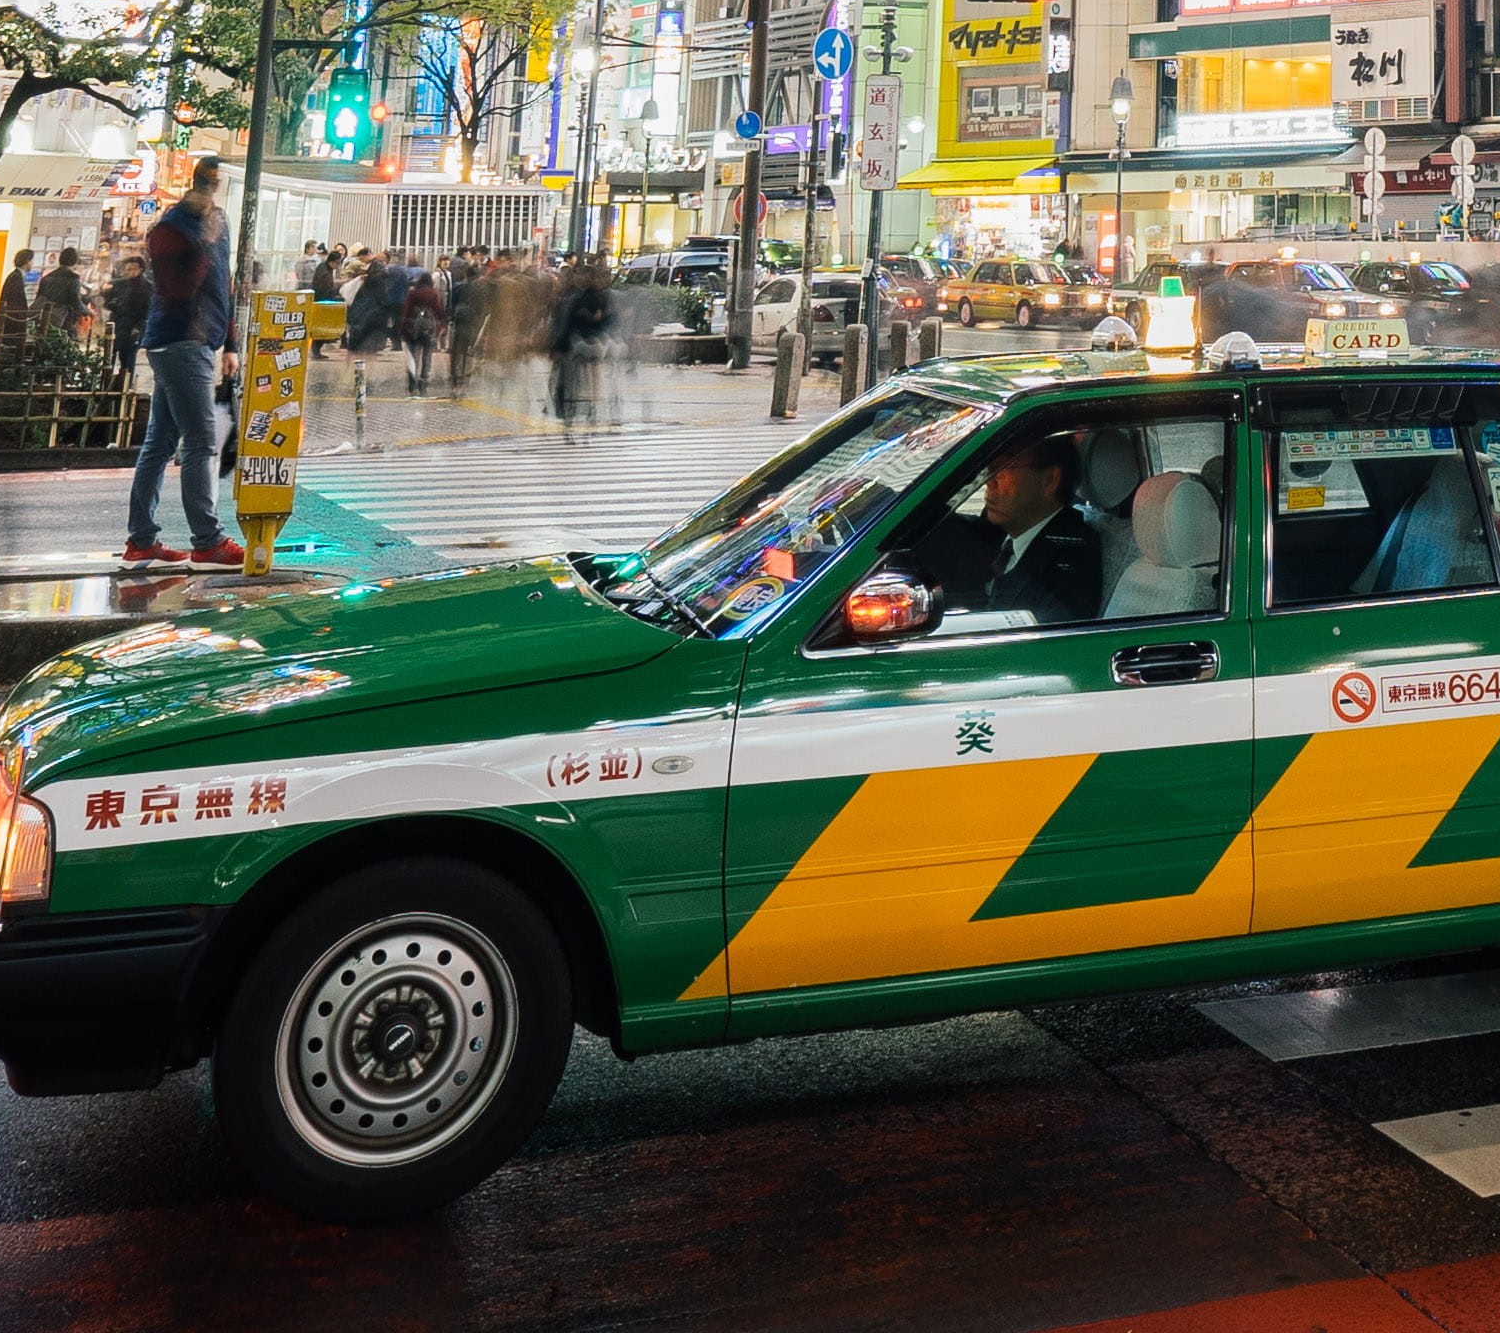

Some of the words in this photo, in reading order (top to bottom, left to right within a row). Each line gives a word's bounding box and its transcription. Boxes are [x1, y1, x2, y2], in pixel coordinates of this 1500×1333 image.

[1334, 27, 1370, 46] うなぎ
[865, 86, 888, 178] 道玄坂
[1332, 328, 1404, 351] CARD
[1333, 321, 1378, 333] CREDIT
[1387, 681, 1447, 703] 東京無線
[955, 709, 996, 756] 葵
[546, 746, 645, 789] (杉並)
[85, 776, 288, 831] 東京無線
